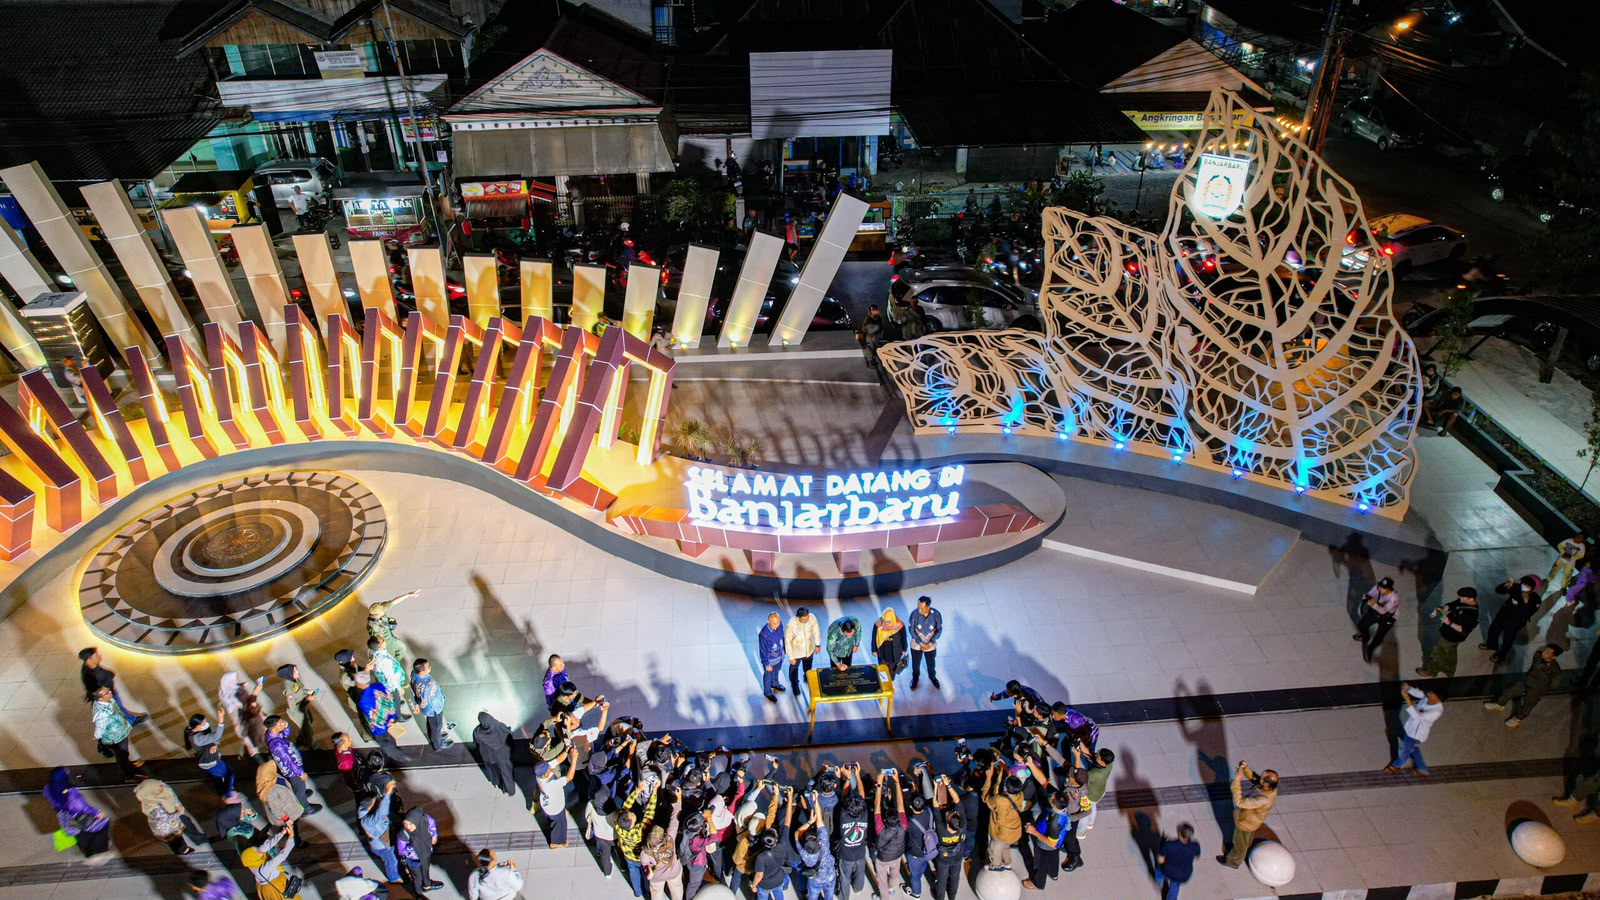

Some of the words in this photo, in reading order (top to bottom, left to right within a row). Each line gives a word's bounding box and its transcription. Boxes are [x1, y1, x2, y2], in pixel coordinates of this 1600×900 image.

[1141, 113, 1194, 122] Angkringan
[687, 466, 813, 496] SELAMAT
[826, 469, 931, 496] DATANG
[939, 464, 965, 488] DI
